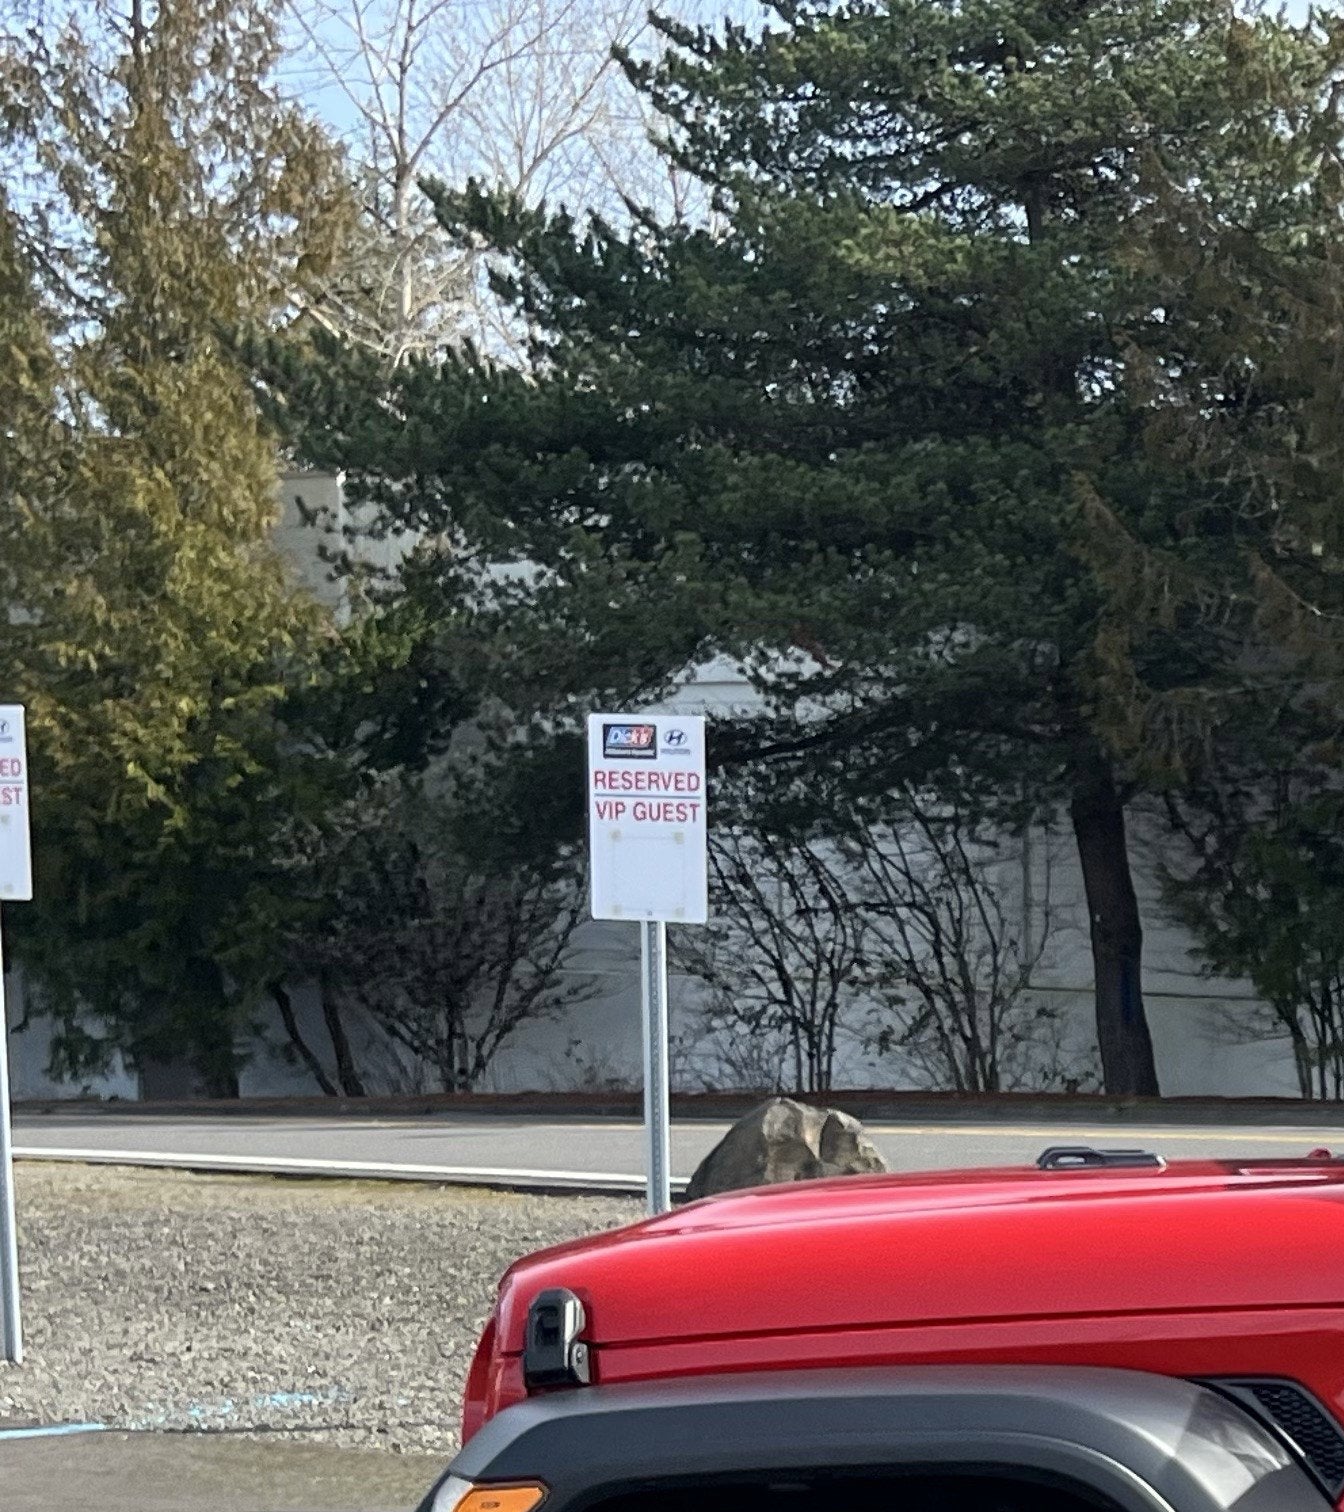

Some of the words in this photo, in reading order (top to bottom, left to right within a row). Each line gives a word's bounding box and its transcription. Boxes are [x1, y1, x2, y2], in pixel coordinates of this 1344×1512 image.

[593, 770, 701, 792] RESERVED
[594, 801, 626, 820] VIP
[632, 802, 701, 823] GUEST
